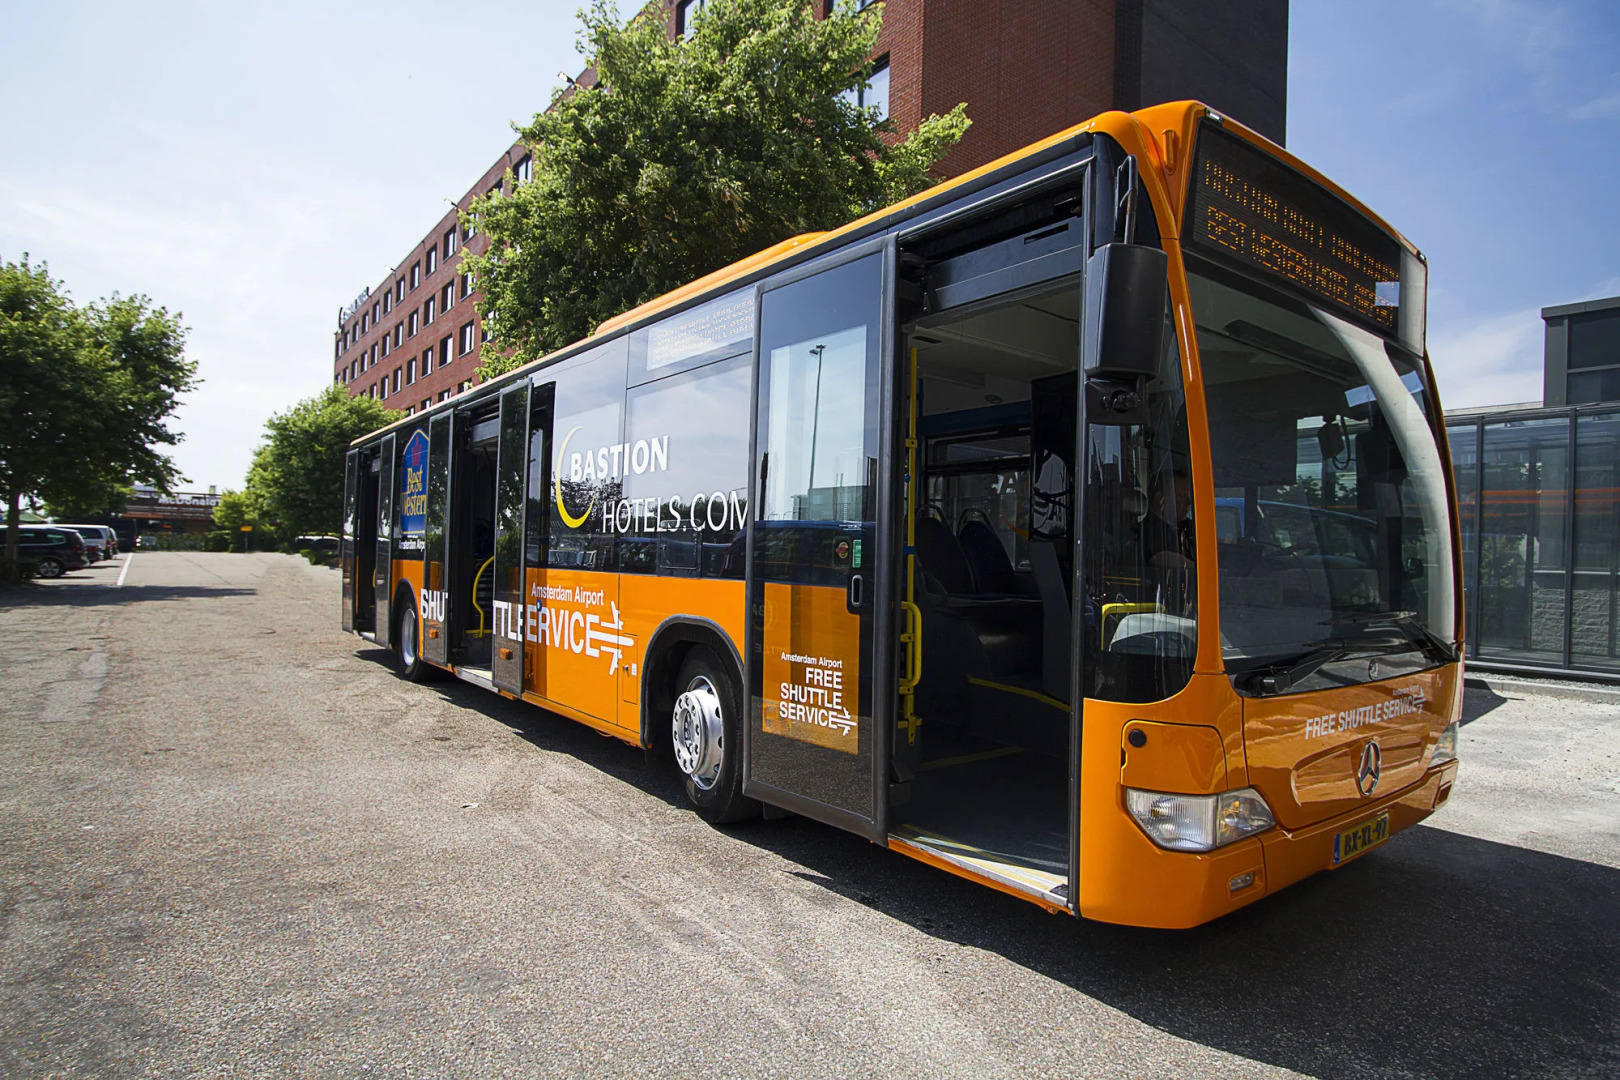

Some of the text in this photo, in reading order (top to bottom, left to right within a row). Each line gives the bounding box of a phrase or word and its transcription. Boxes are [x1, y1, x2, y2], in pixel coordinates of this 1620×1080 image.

[569, 435, 669, 483] BASTION
[407, 464, 423, 494] Best
[531, 582, 604, 608] Amsterdam Airport
[526, 604, 600, 658] ERVICE
[781, 651, 843, 669] Amsterdam Airport
[805, 667, 843, 690] FREE
[780, 682, 843, 710] SHUTTLE
[779, 701, 838, 729] SERVICE
[1304, 694, 1417, 740] FREE SHUTTLE SERVICE
[1344, 816, 1388, 856] BX-XL-97
